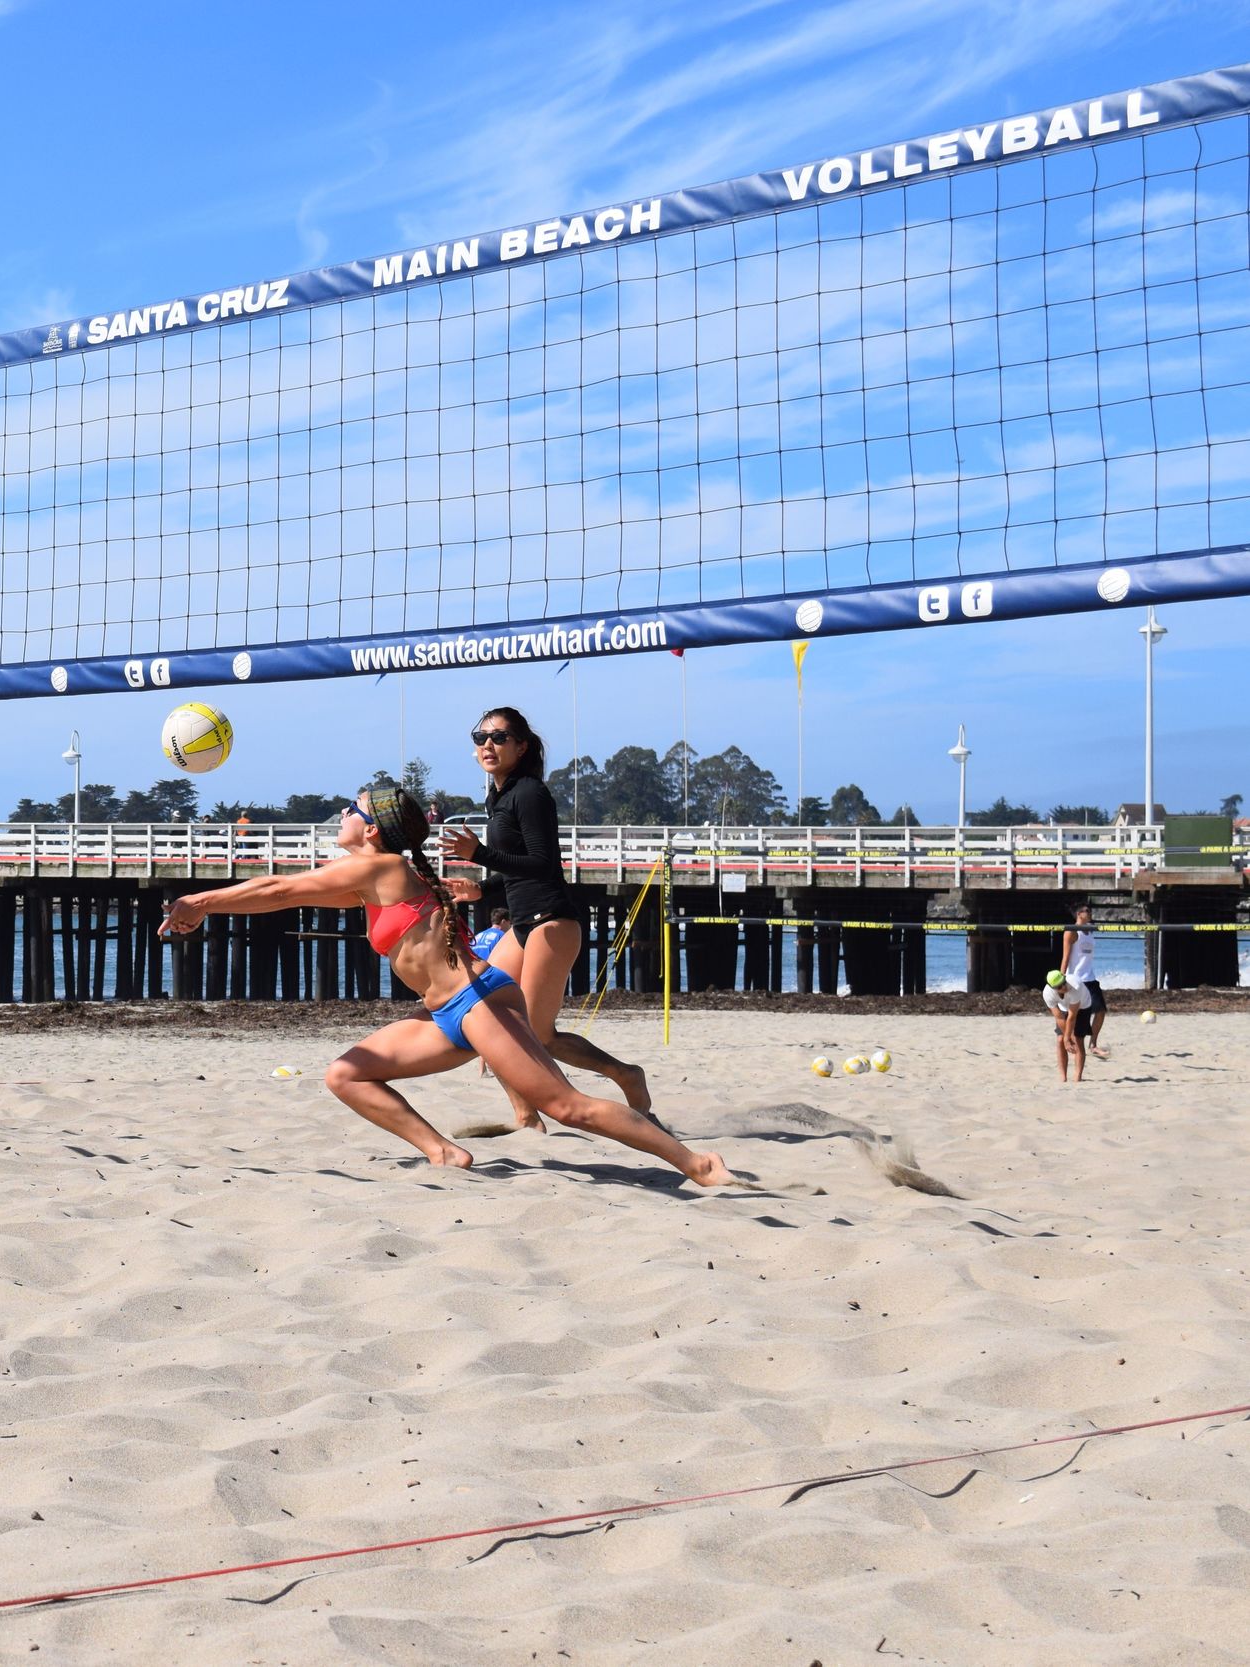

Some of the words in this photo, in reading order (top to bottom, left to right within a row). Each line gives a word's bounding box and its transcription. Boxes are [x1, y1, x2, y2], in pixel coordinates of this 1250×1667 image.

[87, 301, 188, 345] SANTA
[197, 278, 290, 322] CRUZ
[373, 238, 480, 288] MAIN
[499, 199, 662, 261] BEACH
[781, 91, 1160, 201] VOLLEYBALL
[350, 619, 667, 672] www.santacruzwharf.com
[171, 735, 188, 767] Wilson
